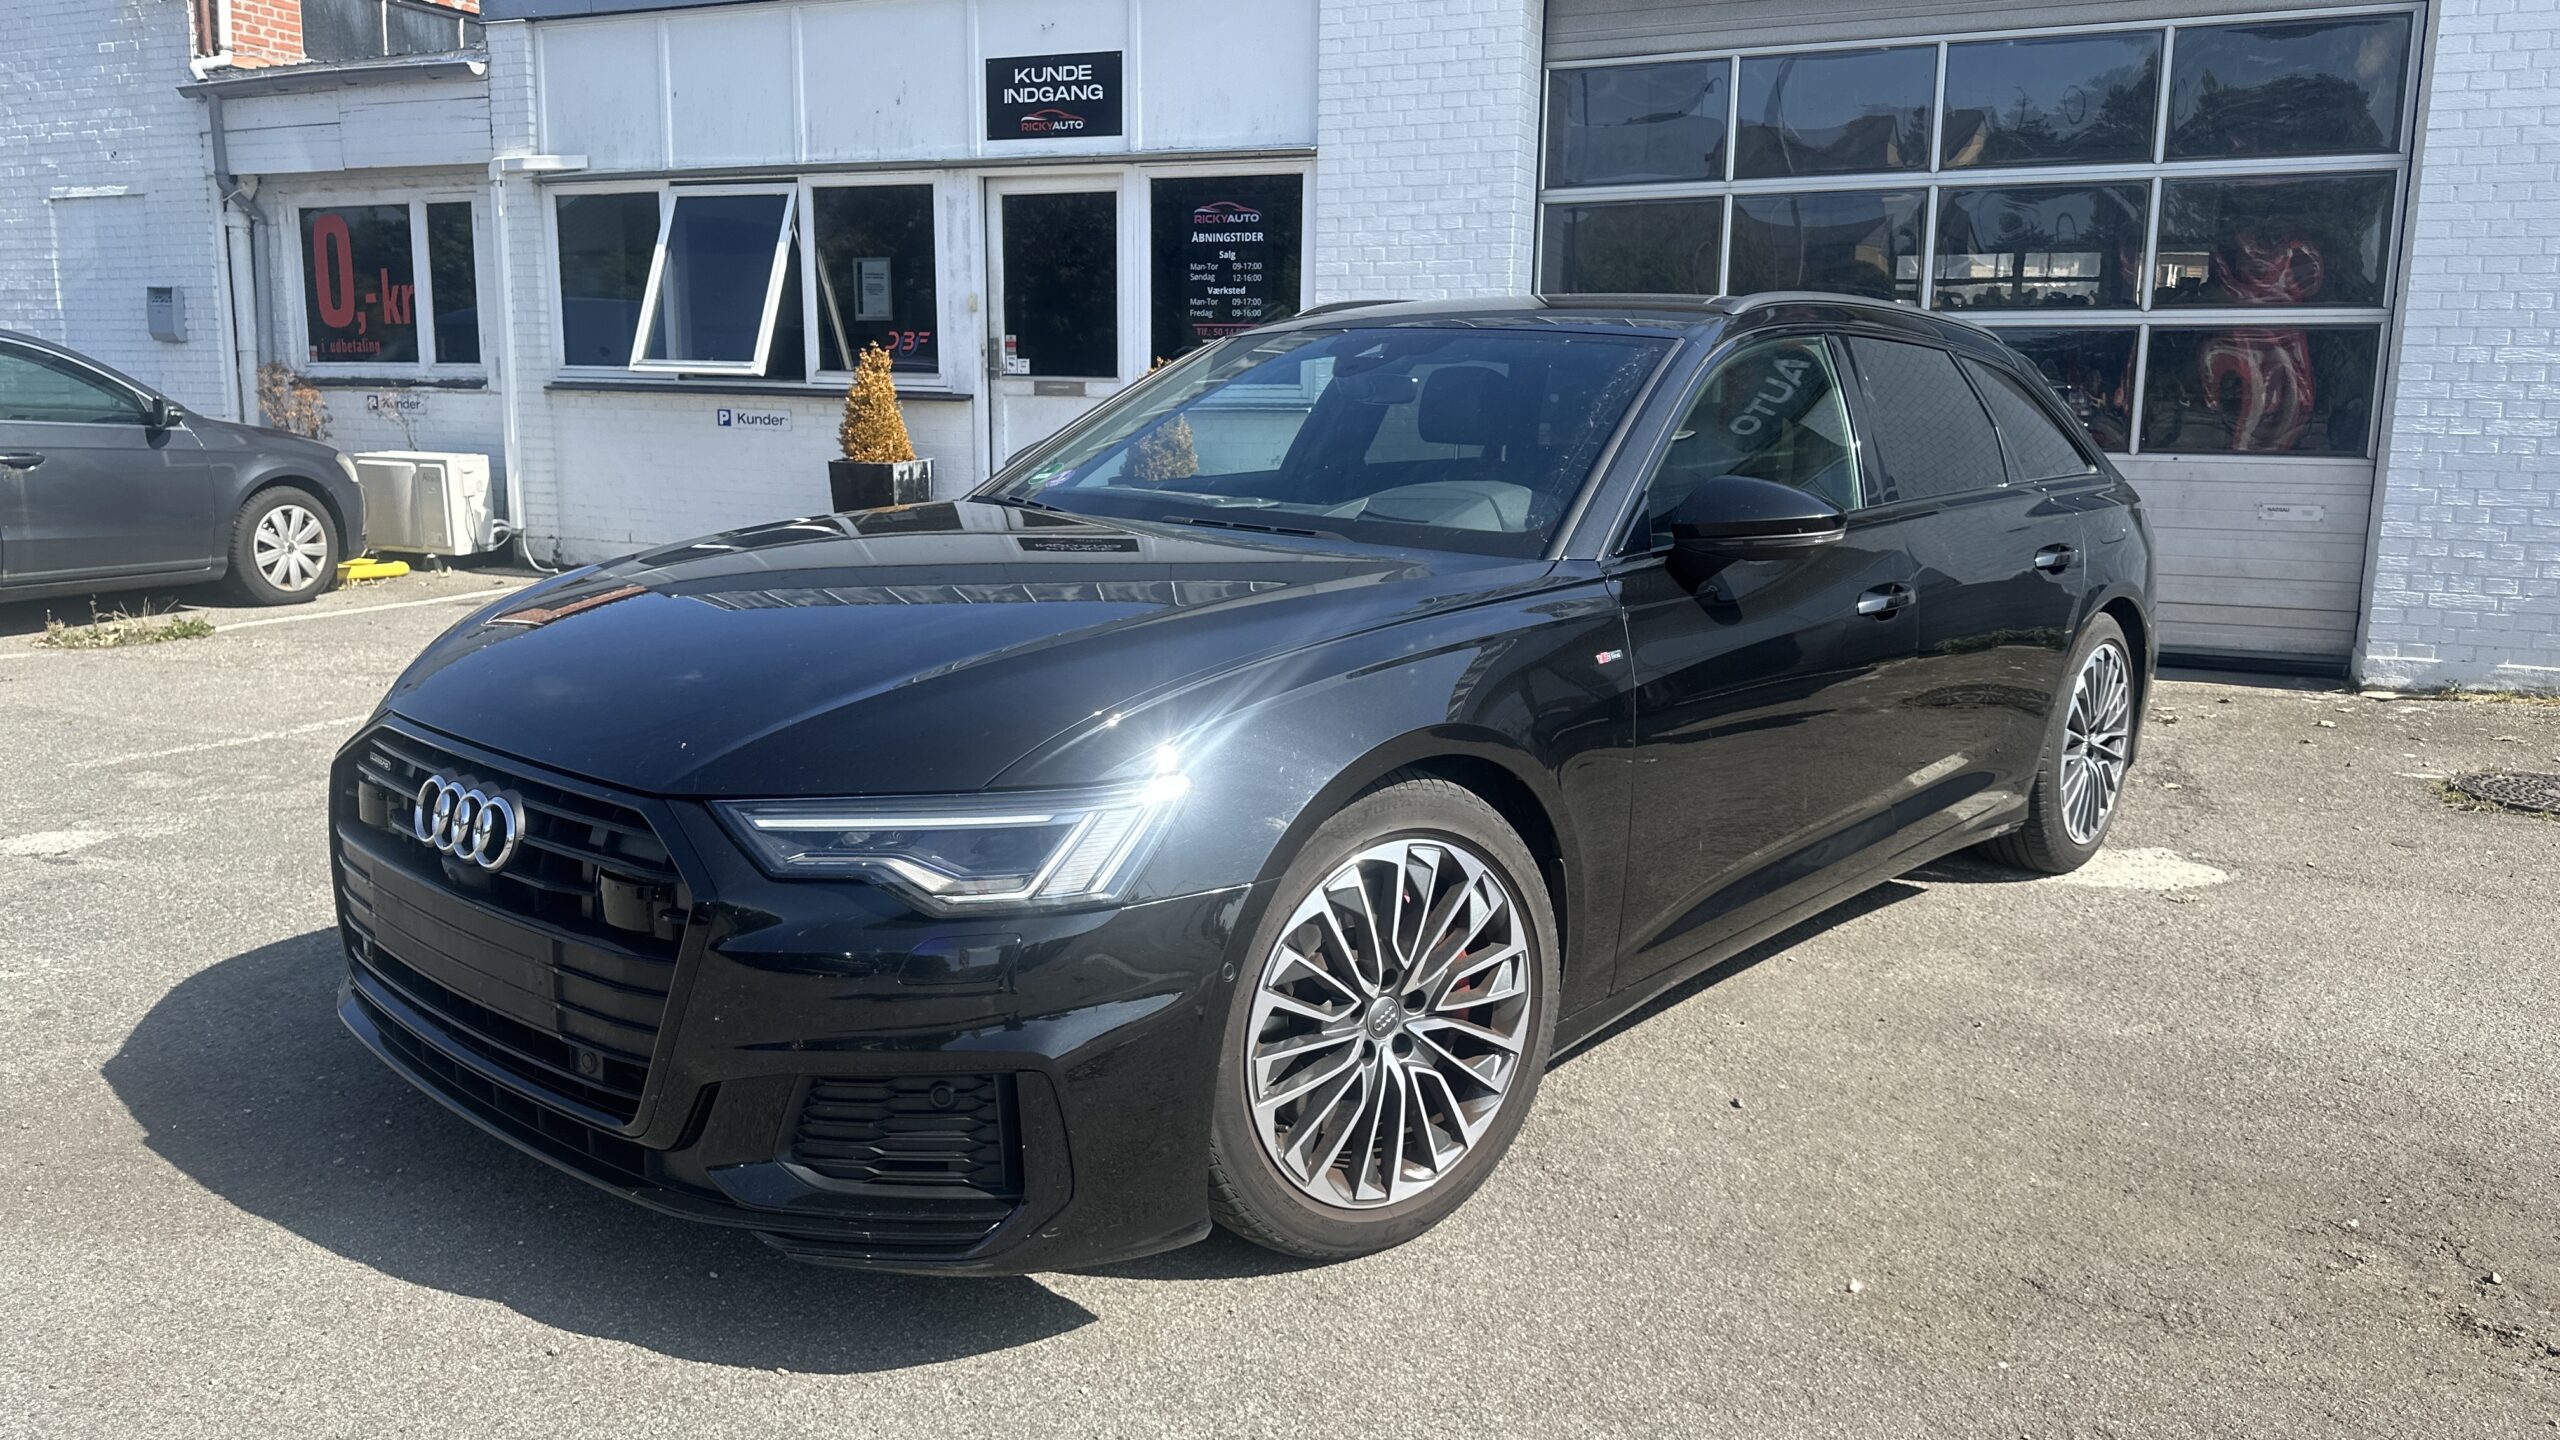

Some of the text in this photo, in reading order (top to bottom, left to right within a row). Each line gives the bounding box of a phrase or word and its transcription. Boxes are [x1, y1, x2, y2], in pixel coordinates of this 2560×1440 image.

[1014, 64, 1092, 84] KUNDE
[1003, 84, 1104, 104] INDGANG
[1021, 120, 1084, 132] RICKYAUTO
[1193, 213, 1260, 224] RICKYAUTO
[1191, 231, 1264, 243] ÅBNINGSTIDER
[1218, 250, 1236, 261] Salg
[1190, 262, 1262, 271] Man-Tor 09-17:00
[1190, 272, 1262, 283] Søndag 12-16:00
[1207, 285, 1246, 295] Værksted
[1190, 297, 1262, 306] Man-Tor 09-17:00
[1189, 308, 1214, 319] Fredag
[330, 337, 381, 356] udbetaling
[737, 412, 785, 426] Kunder
